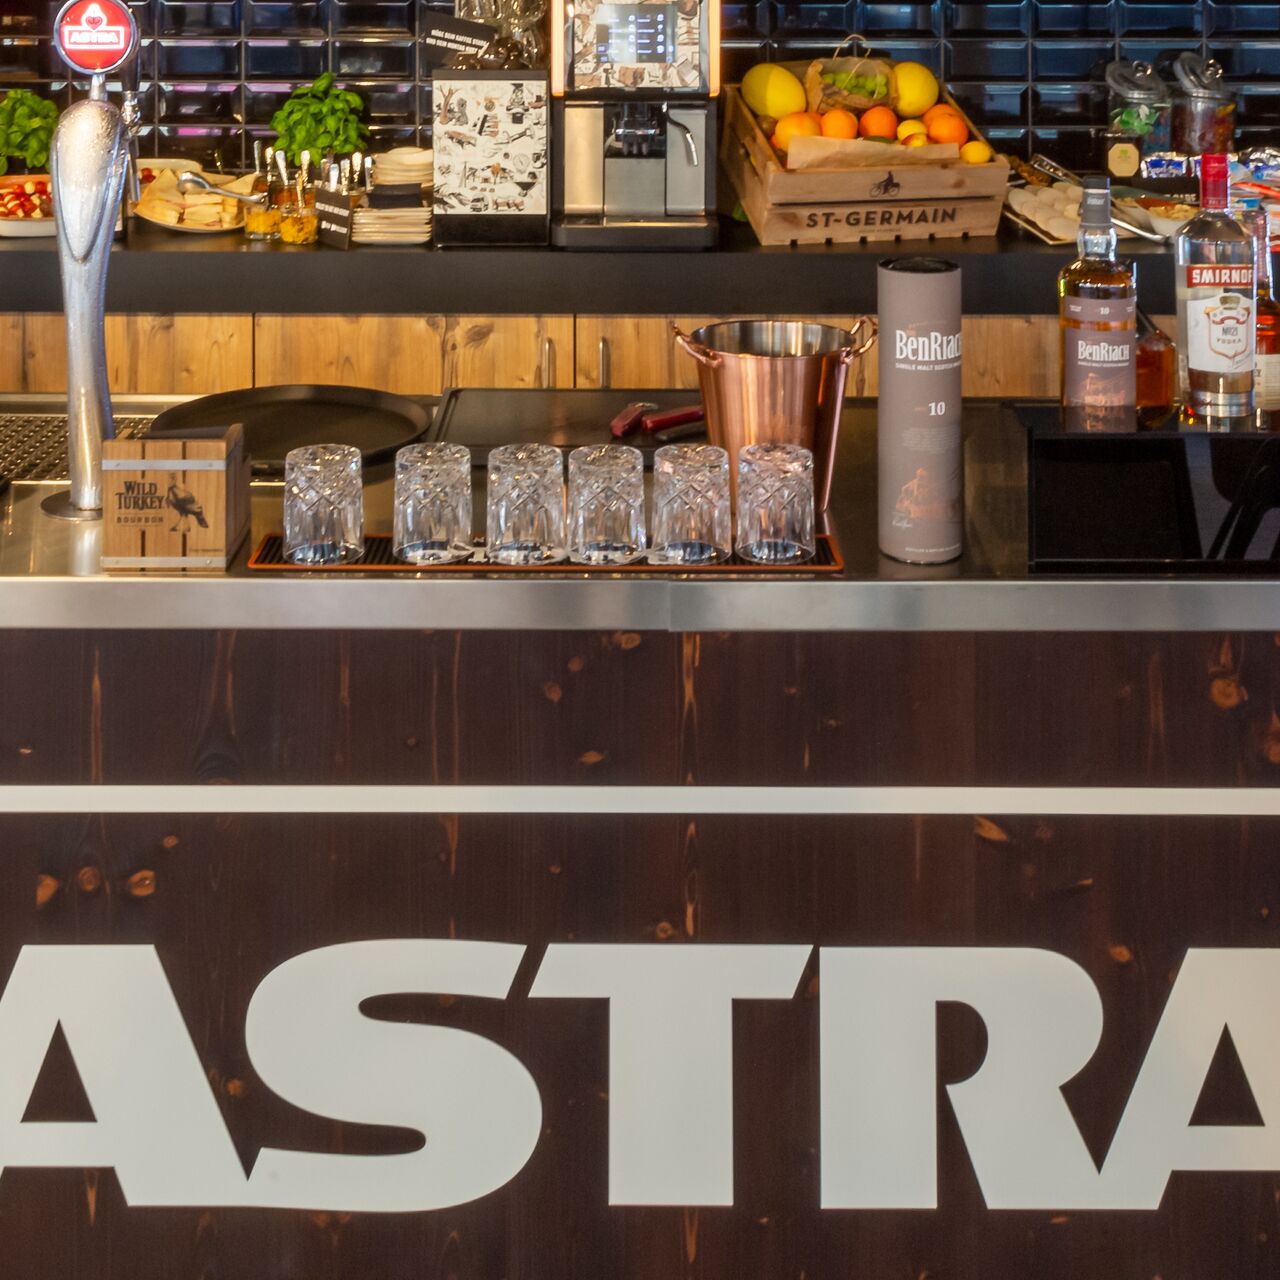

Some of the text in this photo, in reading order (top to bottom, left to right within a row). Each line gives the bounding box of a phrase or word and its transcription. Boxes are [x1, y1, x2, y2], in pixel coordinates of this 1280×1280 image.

[1192, 268, 1253, 283] SMIRNOF
[895, 329, 961, 361] BenRiac
[929, 401, 946, 416] 10
[124, 481, 157, 496] WILD
[115, 492, 166, 510] TURKEY
[117, 516, 163, 524] BOURBON
